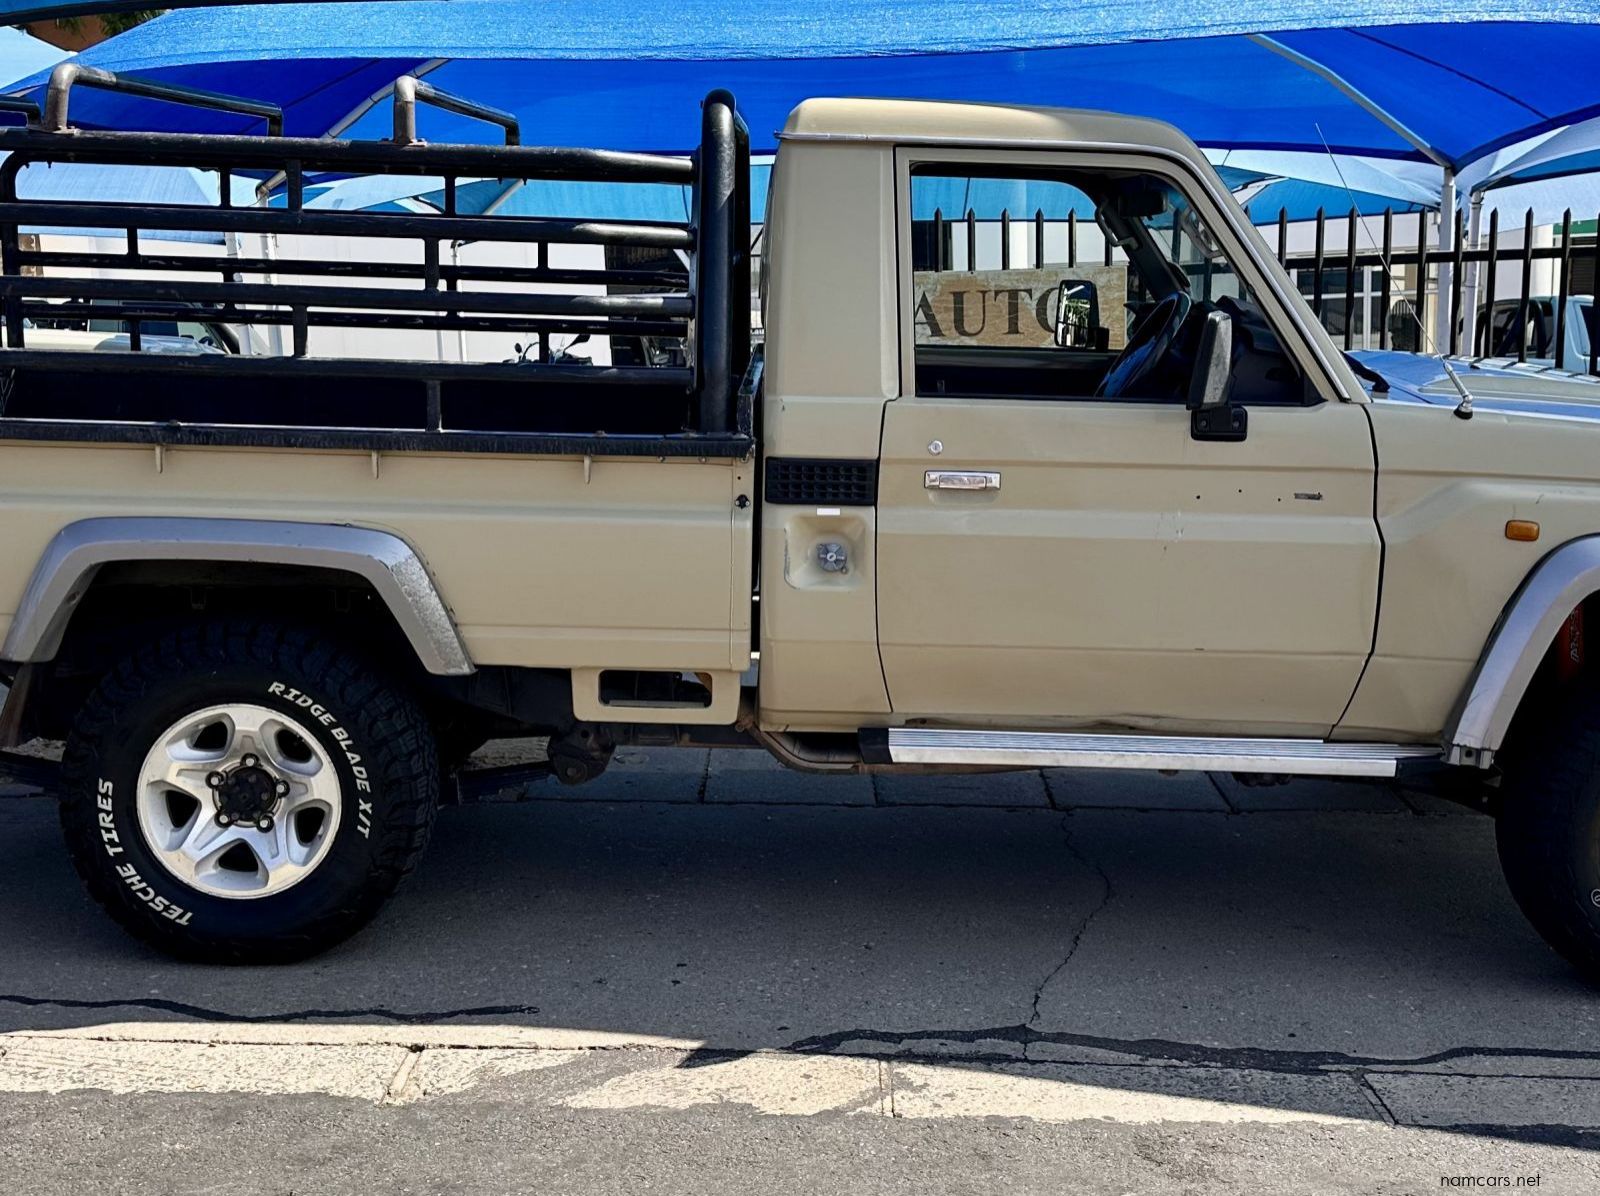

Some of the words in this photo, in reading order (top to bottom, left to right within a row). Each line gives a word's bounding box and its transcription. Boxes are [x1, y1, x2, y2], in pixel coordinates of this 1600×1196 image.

[267, 681, 337, 726] RIDGE
[330, 726, 372, 793] BLADE
[356, 797, 373, 839] X/T
[97, 776, 124, 857] TIRES
[115, 862, 194, 926] TESCHE
